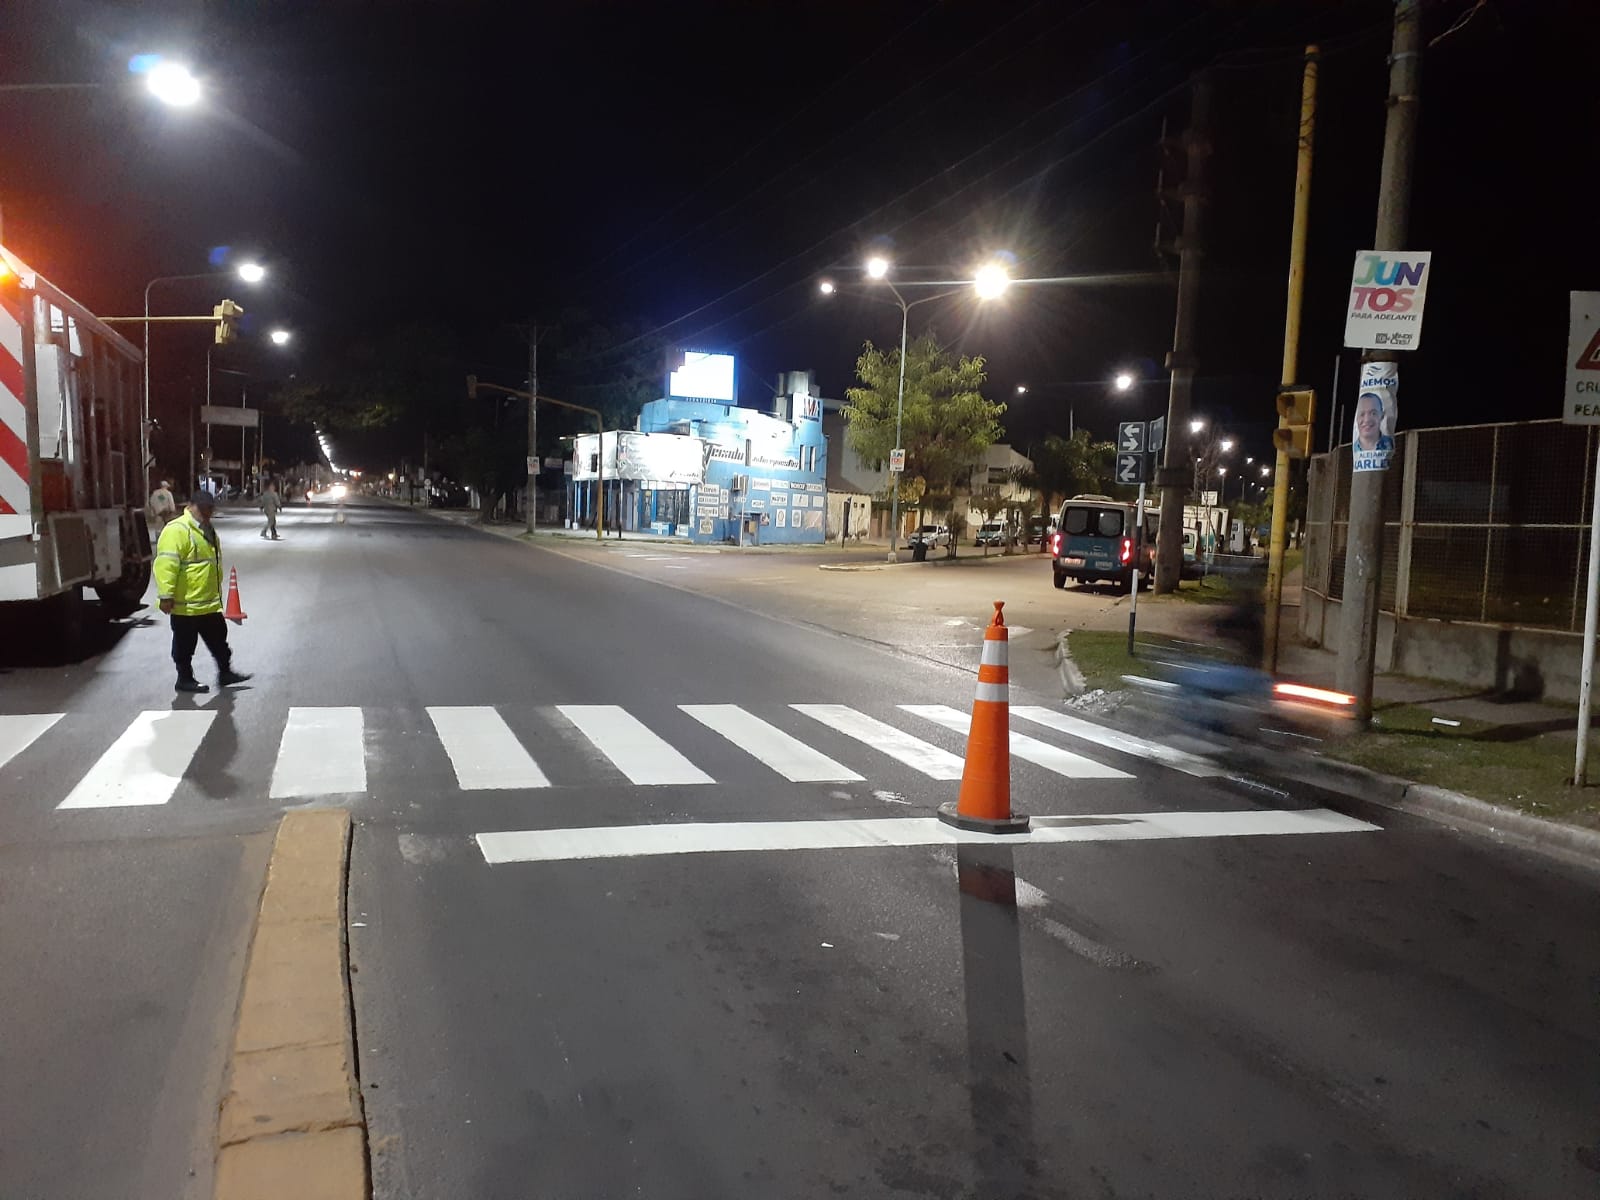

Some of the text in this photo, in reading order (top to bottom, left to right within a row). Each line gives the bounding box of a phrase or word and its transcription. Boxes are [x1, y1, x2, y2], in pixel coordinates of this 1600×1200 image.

[1354, 255, 1426, 286] JUN
[1353, 287, 1416, 313] TOS
[1351, 312, 1417, 321] PARA ADELANTE
[1360, 377, 1396, 388] NEMOS
[1355, 458, 1389, 470] ARLE
